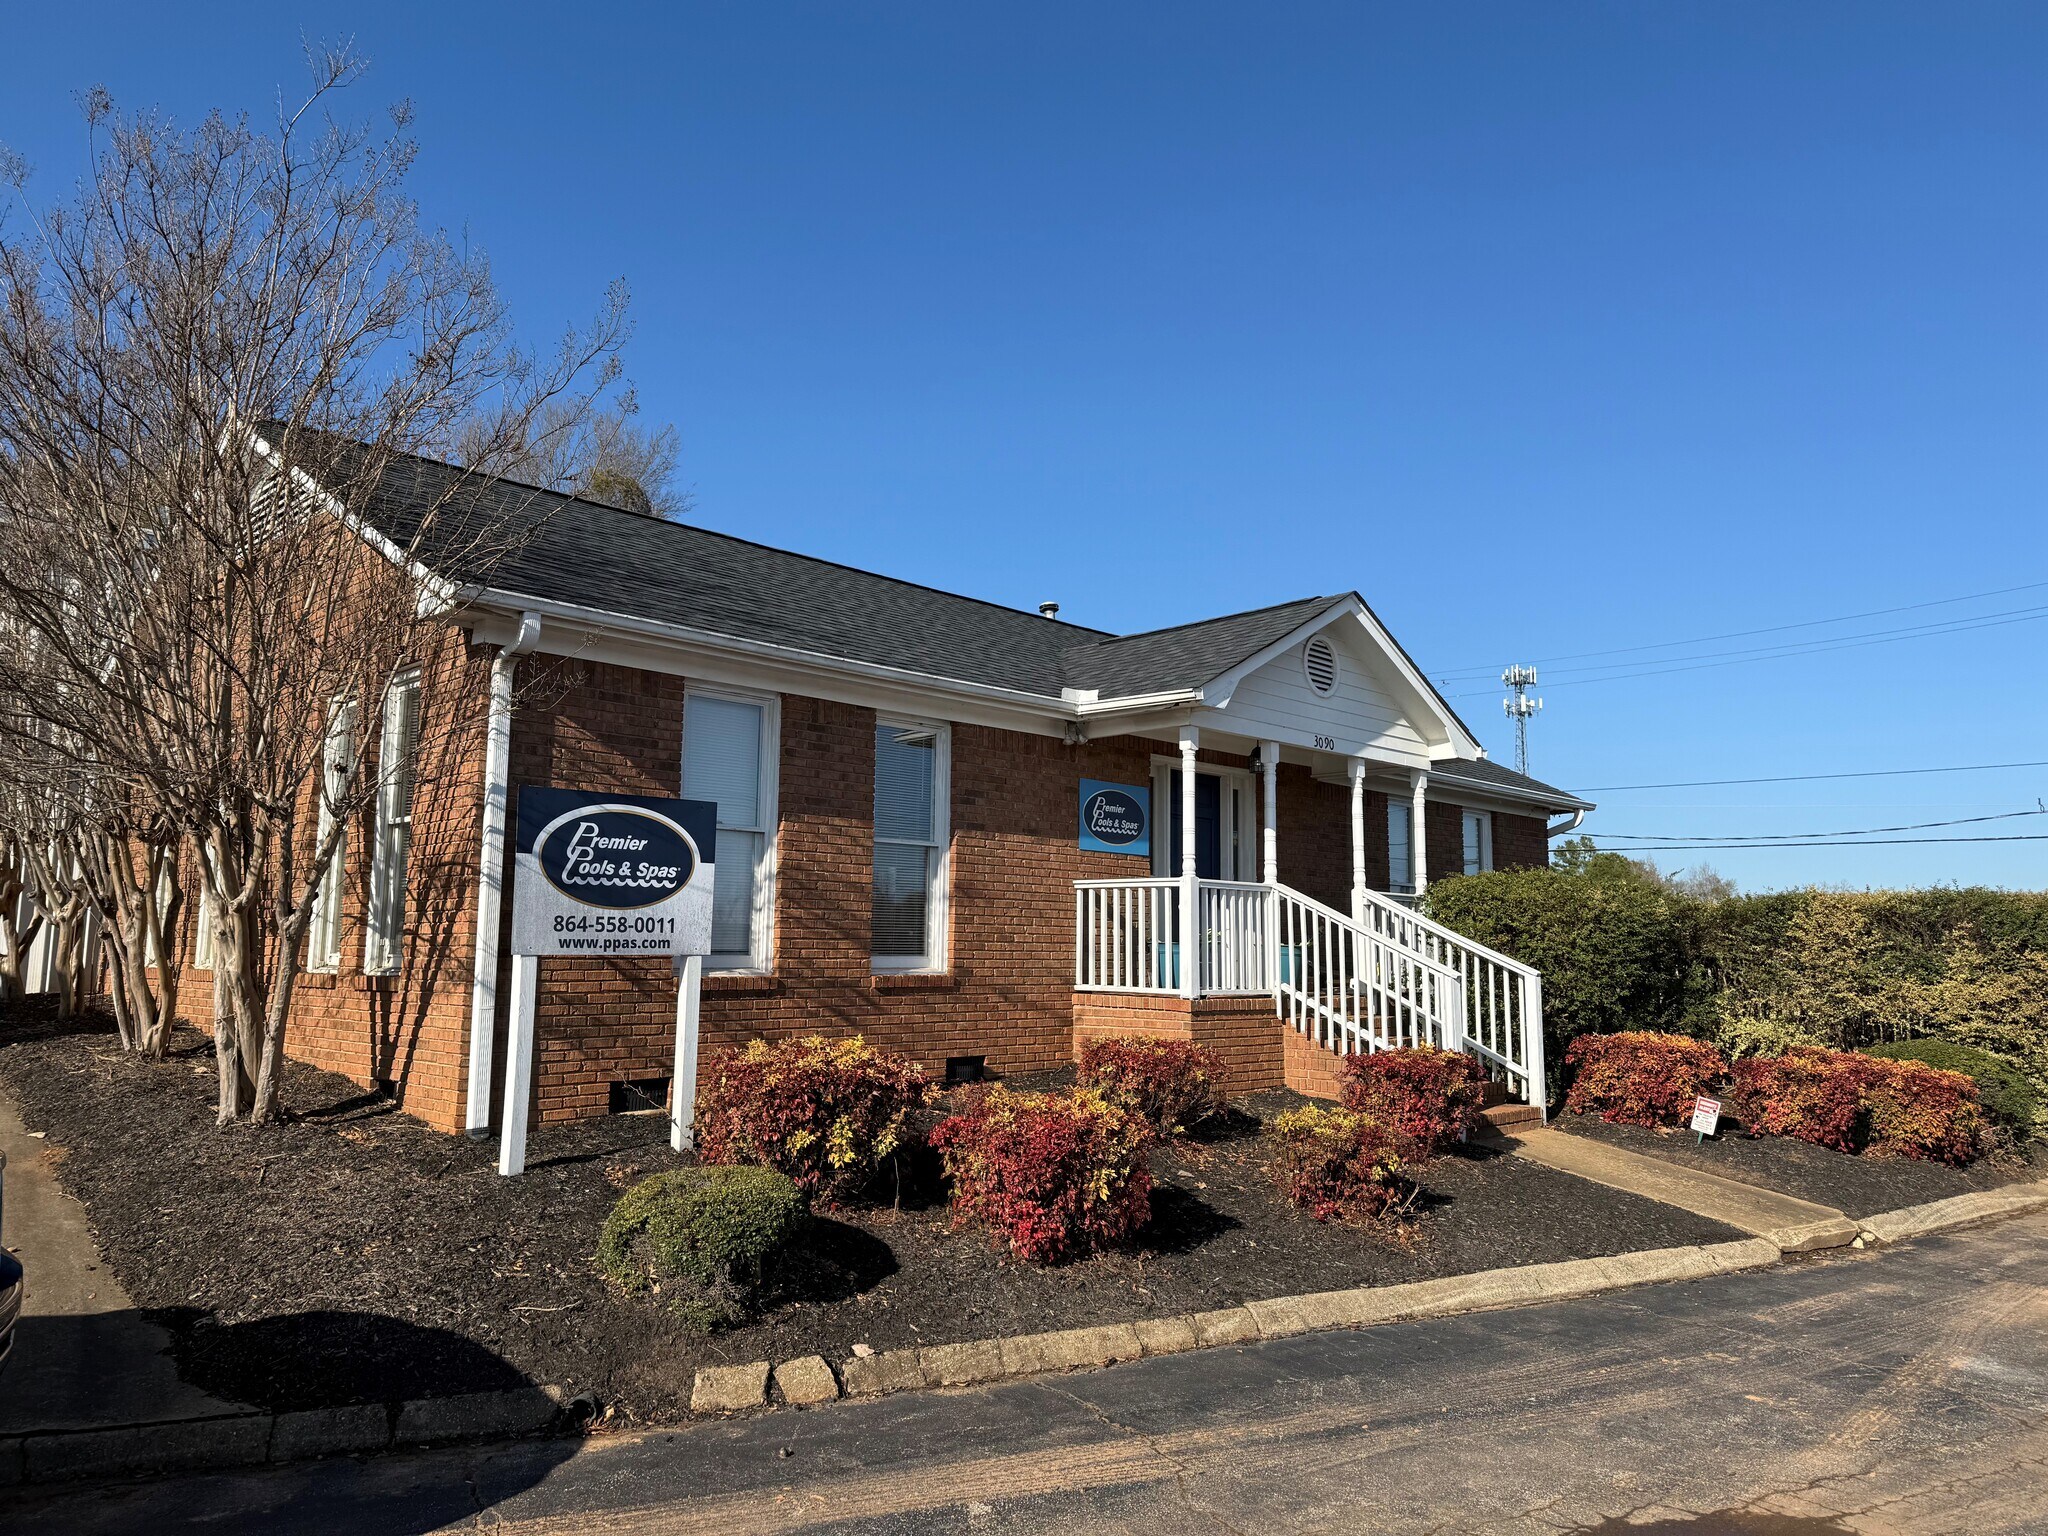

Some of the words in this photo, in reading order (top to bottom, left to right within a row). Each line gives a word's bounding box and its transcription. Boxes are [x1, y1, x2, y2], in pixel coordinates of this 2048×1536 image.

[1314, 735, 1334, 750] 3090
[1093, 796, 1126, 814] Premier
[1092, 810, 1113, 830] Pools
[1113, 819, 1119, 827] &
[1121, 820, 1139, 830] Spas
[566, 822, 649, 857] Premier
[562, 846, 616, 882] Pools
[618, 861, 632, 876] &
[636, 862, 678, 880] Spas
[553, 915, 676, 934] 864-558-0011
[558, 937, 671, 952] www.ppas.com
